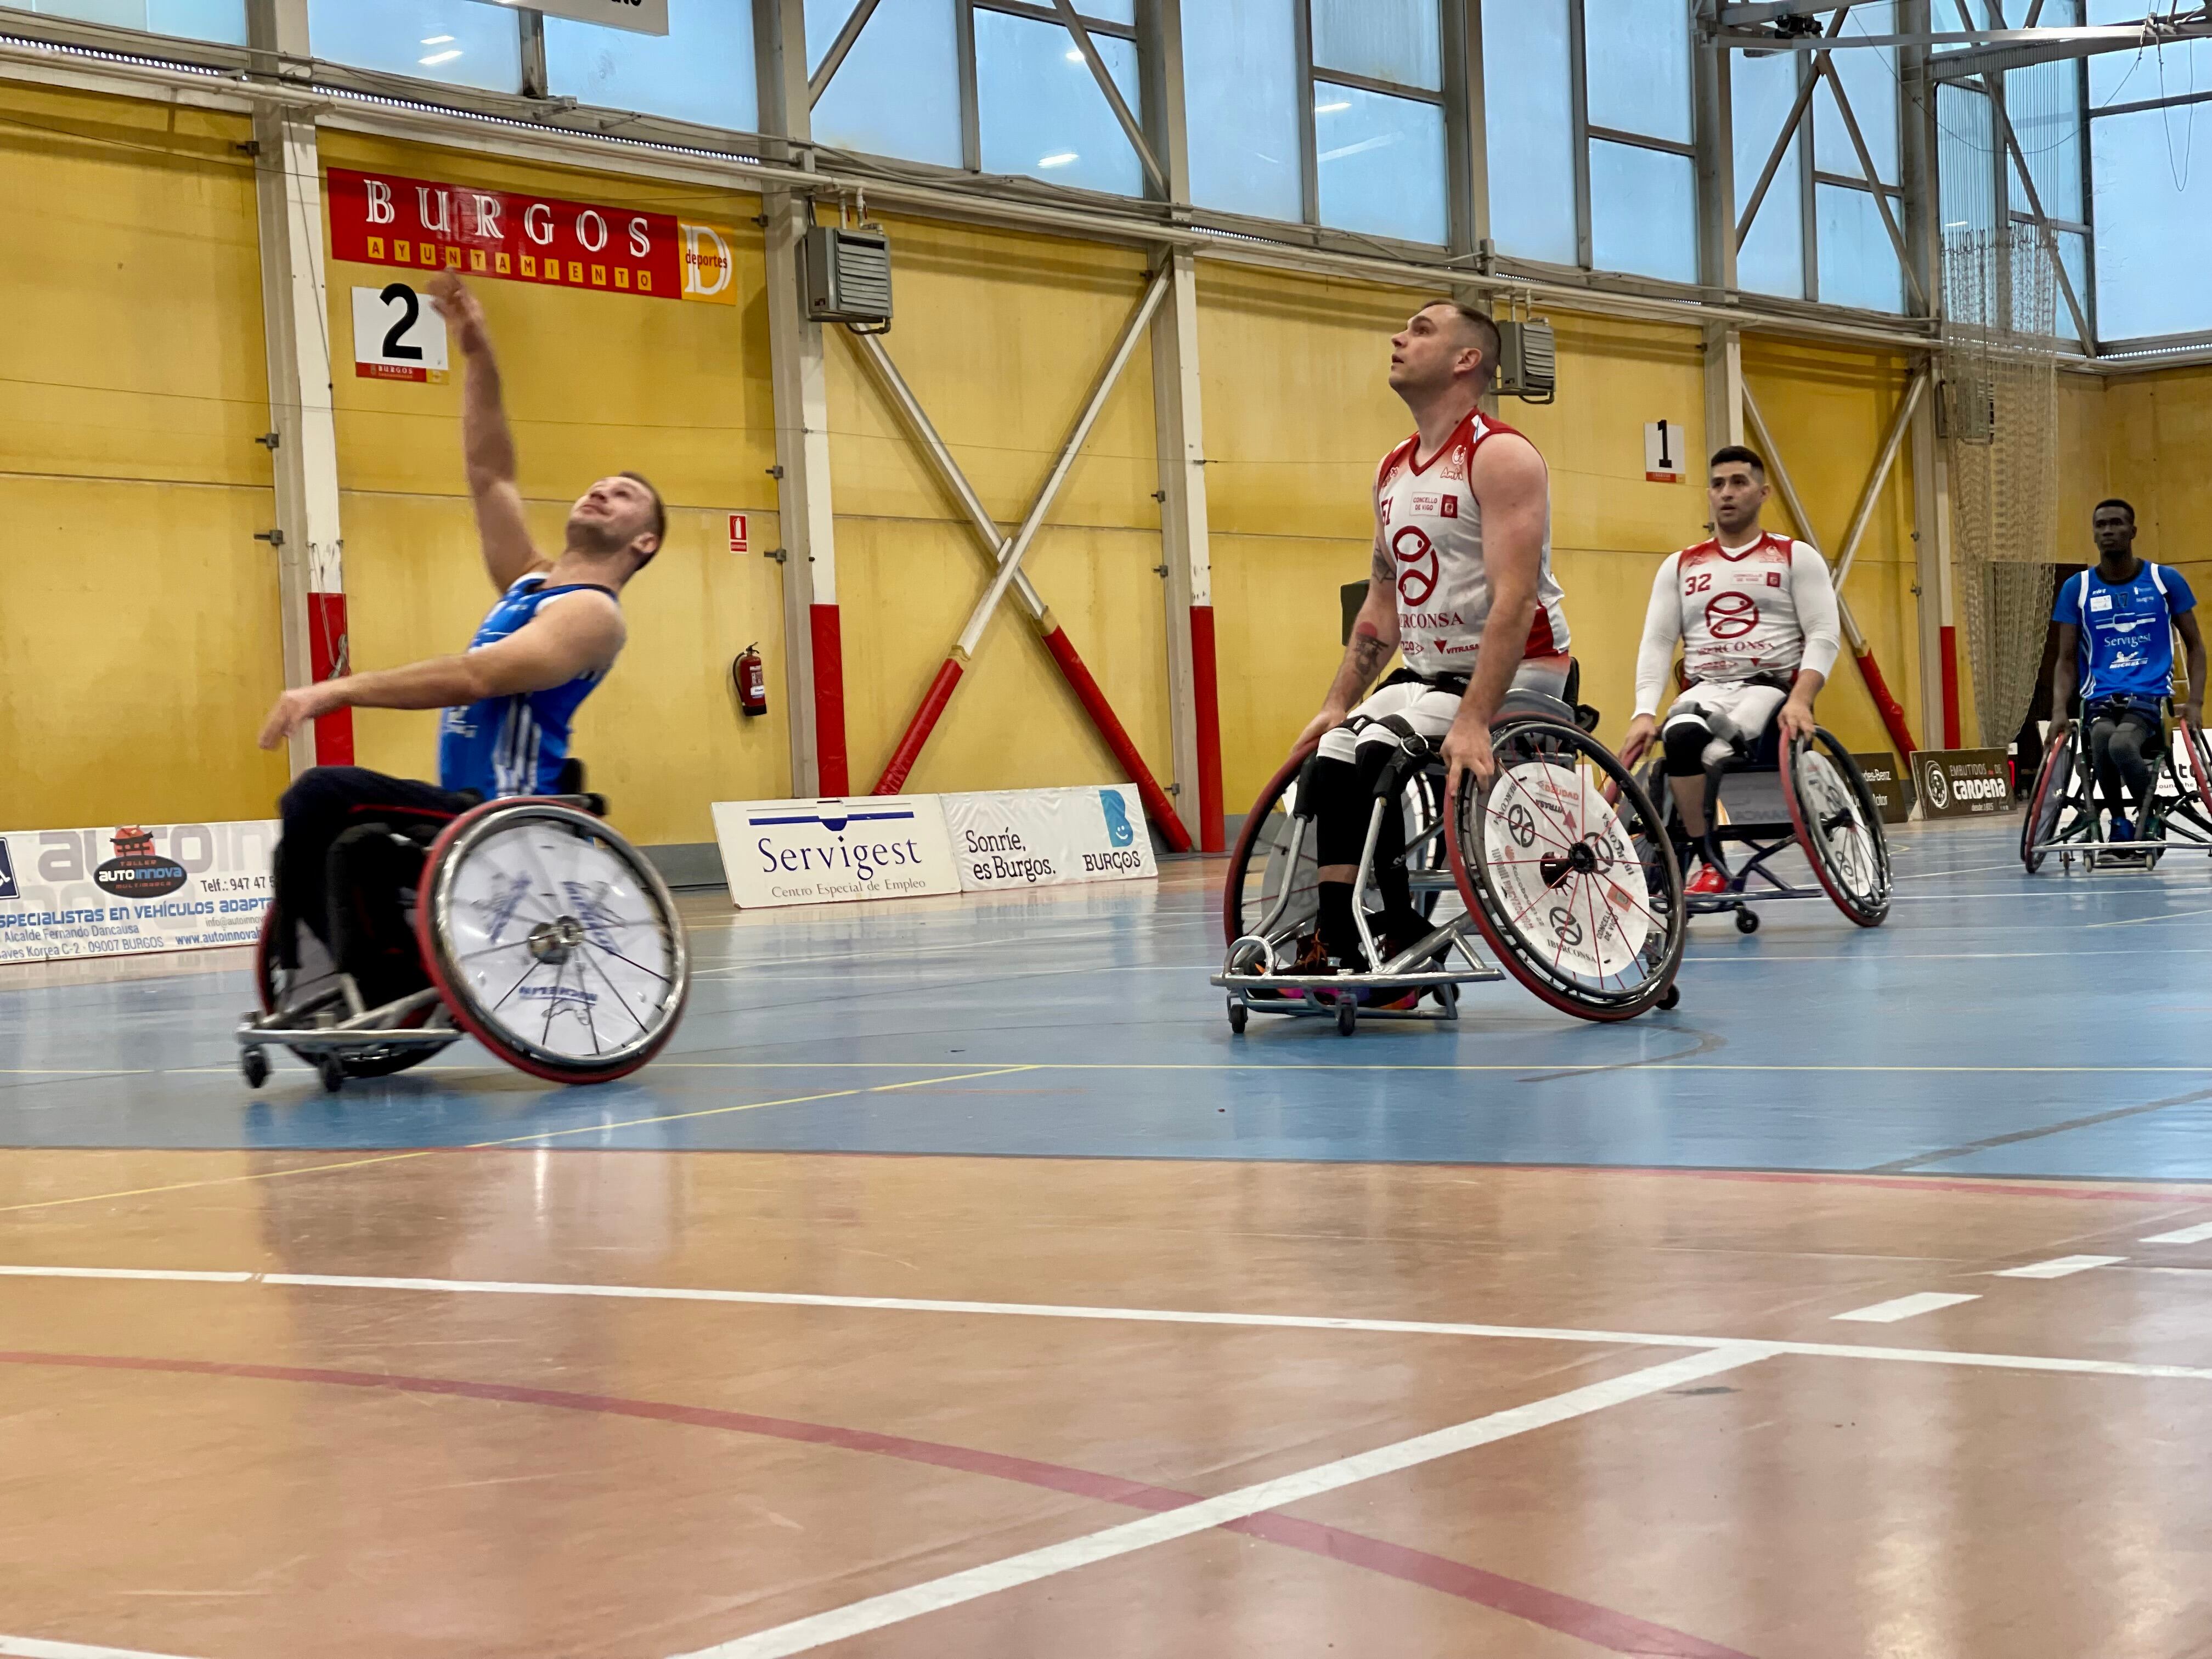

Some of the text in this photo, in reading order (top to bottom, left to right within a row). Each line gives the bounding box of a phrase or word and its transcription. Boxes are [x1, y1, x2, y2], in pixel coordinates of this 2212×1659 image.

[364, 179, 650, 258] BURGOS
[371, 240, 648, 287] AYUNTAMIENTO
[686, 249, 727, 269] deportes
[379, 283, 422, 360] 2
[378, 365, 413, 374] BURGOS
[1657, 419, 1672, 468] 1
[1685, 573, 1712, 596] 32
[2104, 633, 2152, 647] Servigest
[1949, 763, 1987, 776] EMBUTIDOS
[965, 827, 1026, 853] Sonríe,
[758, 835, 922, 881] Servigest
[973, 855, 1056, 883] es Burgos.
[1082, 850, 1141, 873] BURGOS
[230, 877, 250, 891] 947
[254, 876, 266, 889] 47
[771, 878, 926, 898] Centro Especial de Empleo
[134, 900, 215, 919] VEHÍCULOS
[4, 924, 140, 943] Alcalde Fernando Dancausa
[205, 916, 263, 928] info@autoinnov
[0, 936, 164, 960] aves Korrea C-2 09007 BURGOS
